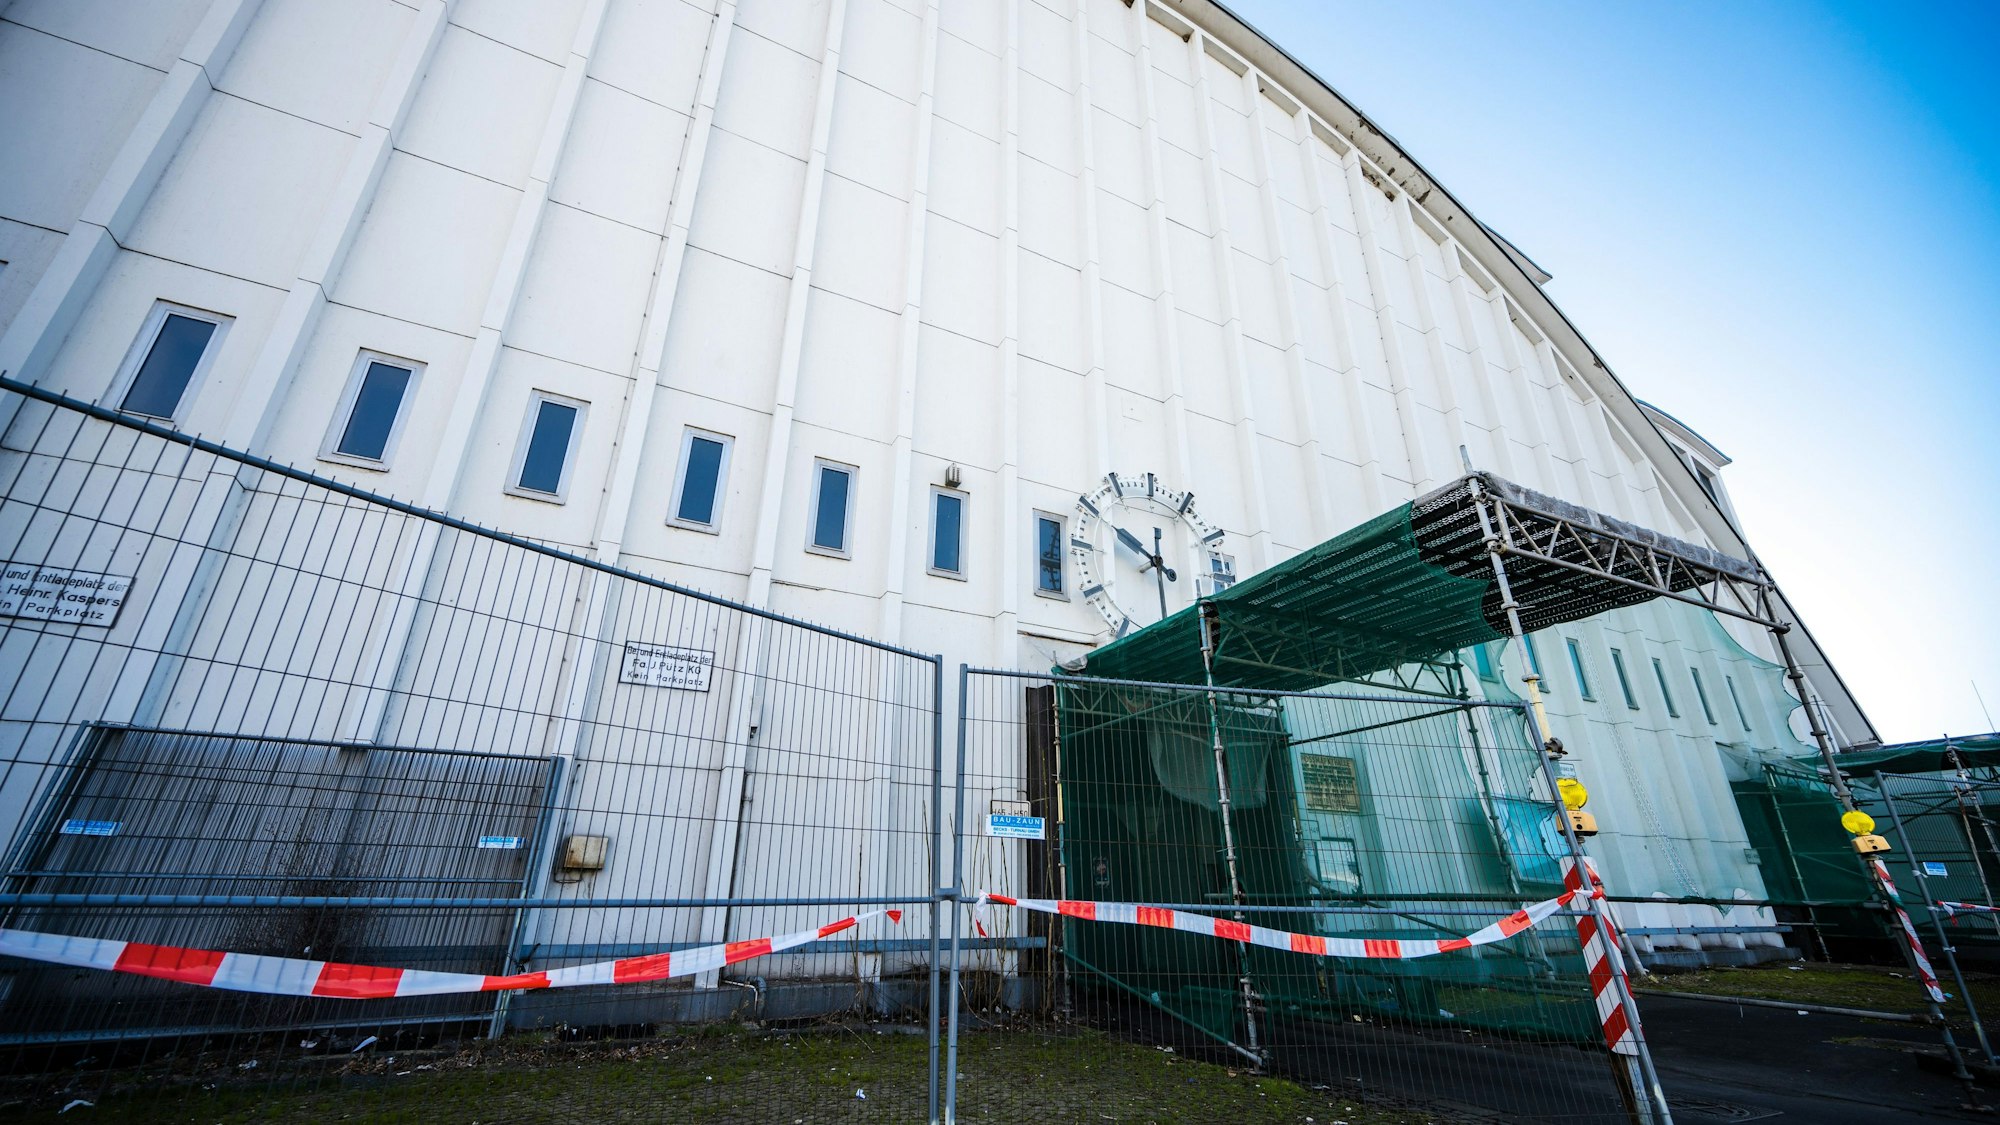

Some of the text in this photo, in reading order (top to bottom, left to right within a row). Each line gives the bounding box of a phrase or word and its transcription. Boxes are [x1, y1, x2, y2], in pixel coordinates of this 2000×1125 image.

[6, 569, 31, 580] und
[33, 571, 105, 590] Entladeplatz
[7, 584, 52, 599] Heinr.
[57, 590, 121, 606] Kaspers
[25, 602, 105, 620] Parkplatz
[640, 648, 653, 656] und
[700, 655, 712, 664] der
[632, 658, 648, 669] Fa.
[687, 665, 702, 675] KG
[627, 670, 704, 686] Kein Parkplatz
